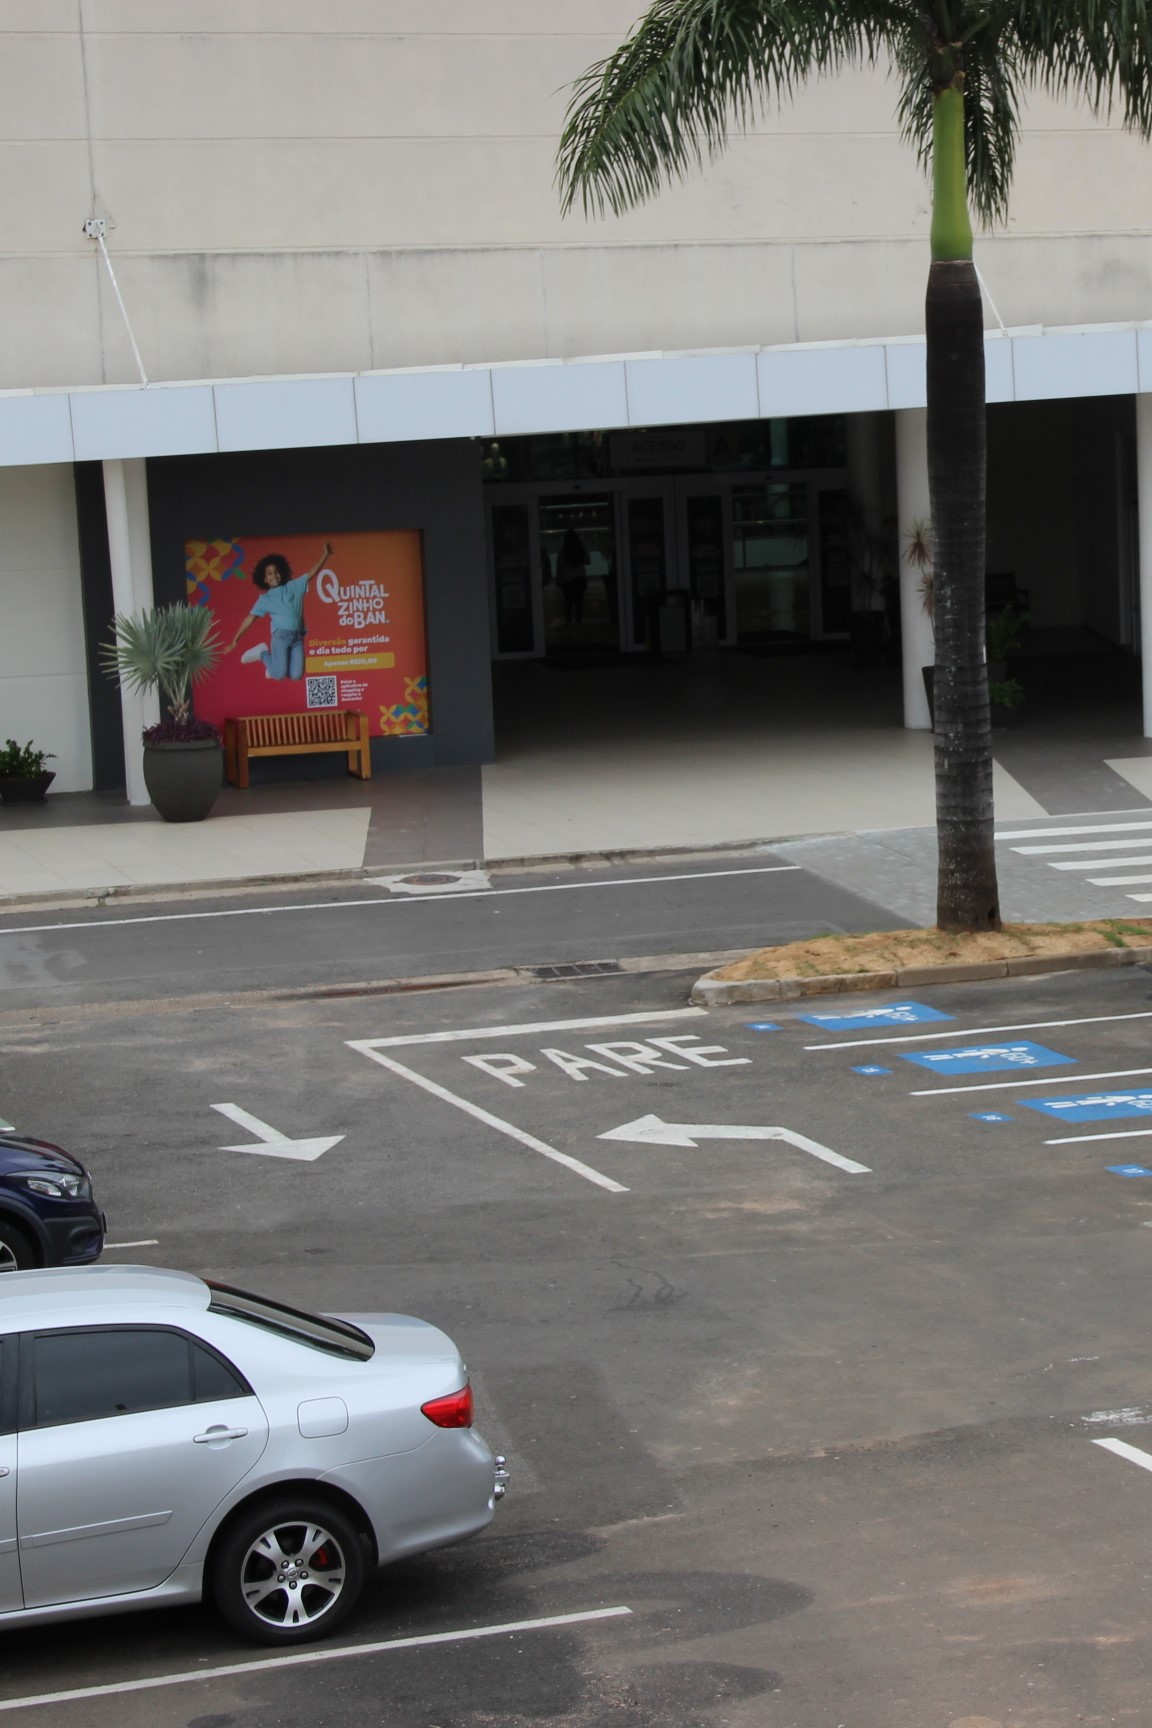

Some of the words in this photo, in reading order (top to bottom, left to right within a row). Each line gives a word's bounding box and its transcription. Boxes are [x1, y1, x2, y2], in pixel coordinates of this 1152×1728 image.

[317, 569, 389, 603] QUINTAL
[338, 598, 384, 615] ZINHO
[309, 637, 347, 647] Diversão
[348, 634, 390, 646] garantida
[316, 647, 330, 655] dia
[331, 646, 352, 654] todo
[353, 646, 368, 654] por
[461, 1034, 753, 1088] PARE
